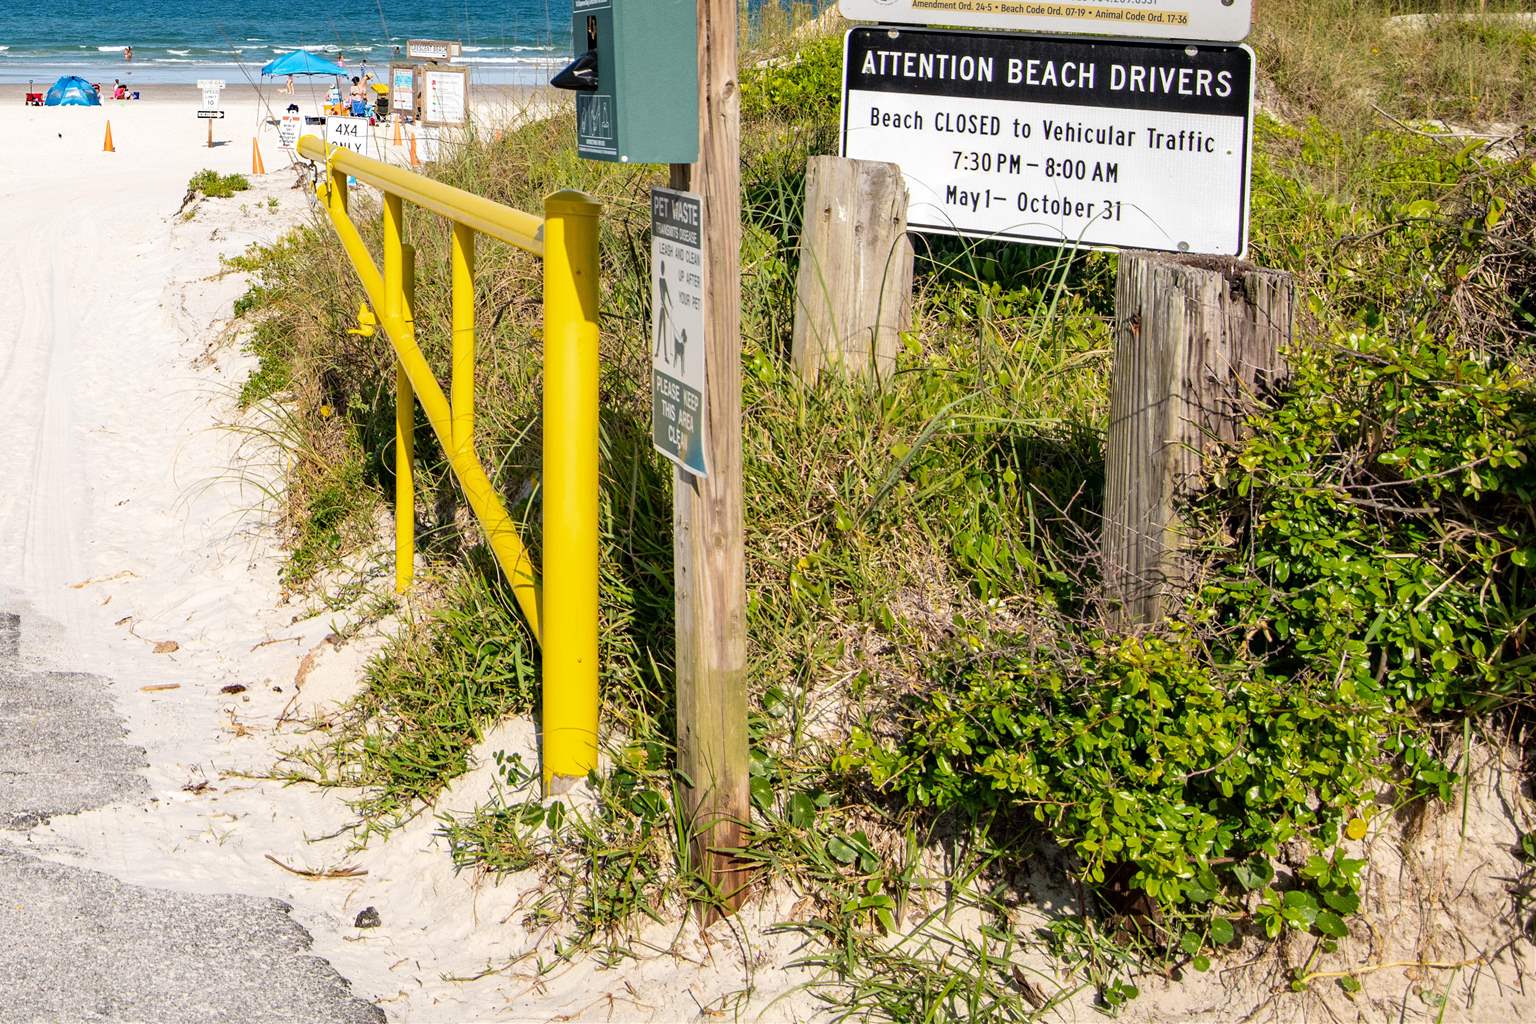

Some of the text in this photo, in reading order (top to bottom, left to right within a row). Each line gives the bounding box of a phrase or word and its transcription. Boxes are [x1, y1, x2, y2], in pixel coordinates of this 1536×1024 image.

[911, 0, 1188, 24] Amendment Ord. 24-5 Beach Code Ord. 07-19 Animal Code Ord. 17-36
[861, 49, 1233, 98] ATTENTION BEACH DRIVERS
[870, 107, 1215, 153] Beach CLOSED to Vehicular Traffic
[952, 151, 992, 172] 7:30
[997, 153, 1021, 174] PM
[1045, 157, 1086, 180] 8:00
[1092, 161, 1119, 183] AM
[653, 196, 699, 227] PET WASTE
[1017, 192, 1095, 218] October
[1102, 200, 1122, 222] 31
[656, 375, 680, 403] PLEASE
[661, 399, 676, 422] THIS
